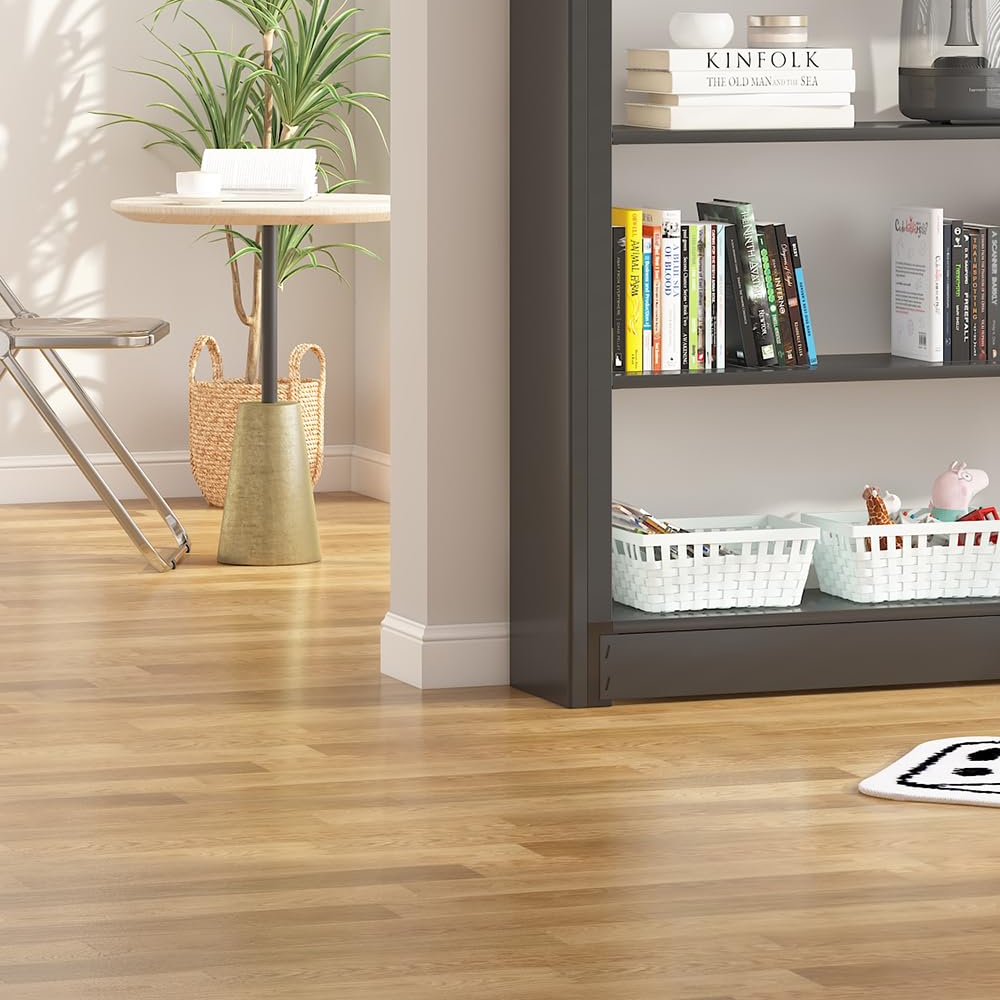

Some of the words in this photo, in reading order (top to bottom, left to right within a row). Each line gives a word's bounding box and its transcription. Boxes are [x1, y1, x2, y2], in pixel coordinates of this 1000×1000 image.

[707, 52, 820, 68] KINFOLK
[706, 76, 727, 87] THE
[728, 76, 749, 87] OLD
[750, 76, 772, 87] MAN
[800, 76, 818, 87] SEA
[630, 240, 640, 272] ANIMAL
[664, 247, 672, 260] OF
[630, 275, 638, 296] FARM
[774, 277, 785, 314] INFERNO
